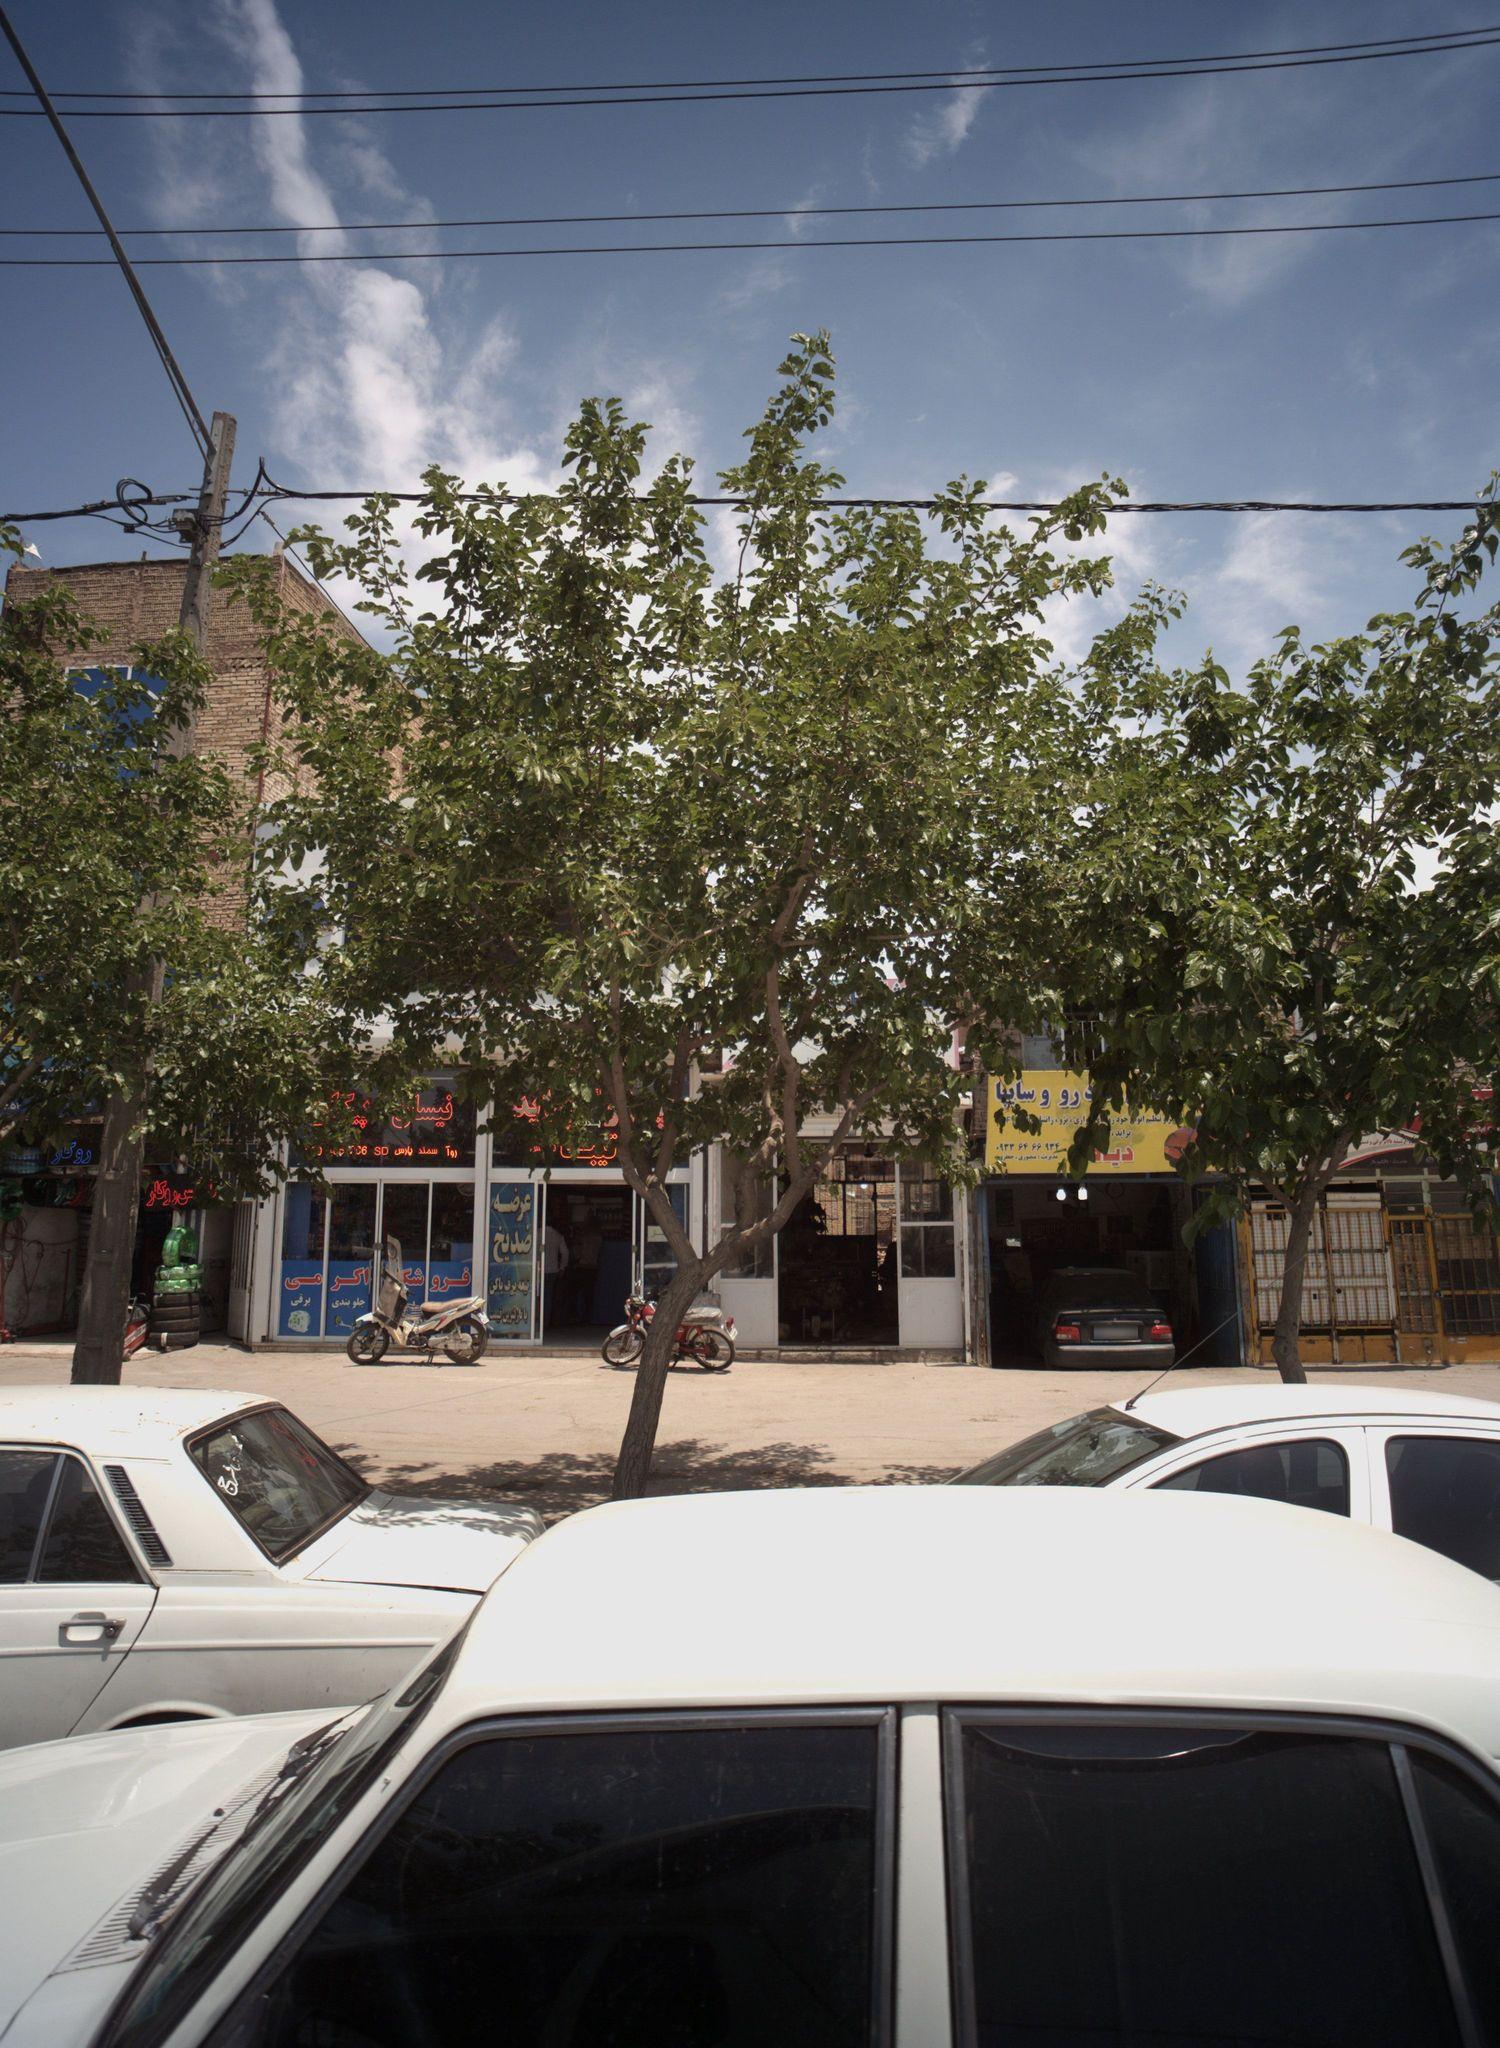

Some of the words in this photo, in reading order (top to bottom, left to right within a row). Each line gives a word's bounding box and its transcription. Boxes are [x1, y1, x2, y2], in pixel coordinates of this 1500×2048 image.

[373, 1146, 389, 1156] SD
[493, 1187, 531, 1221] عرضه
[492, 1225, 532, 1263] ضدیخ
[290, 1293, 311, 1306] برقی
